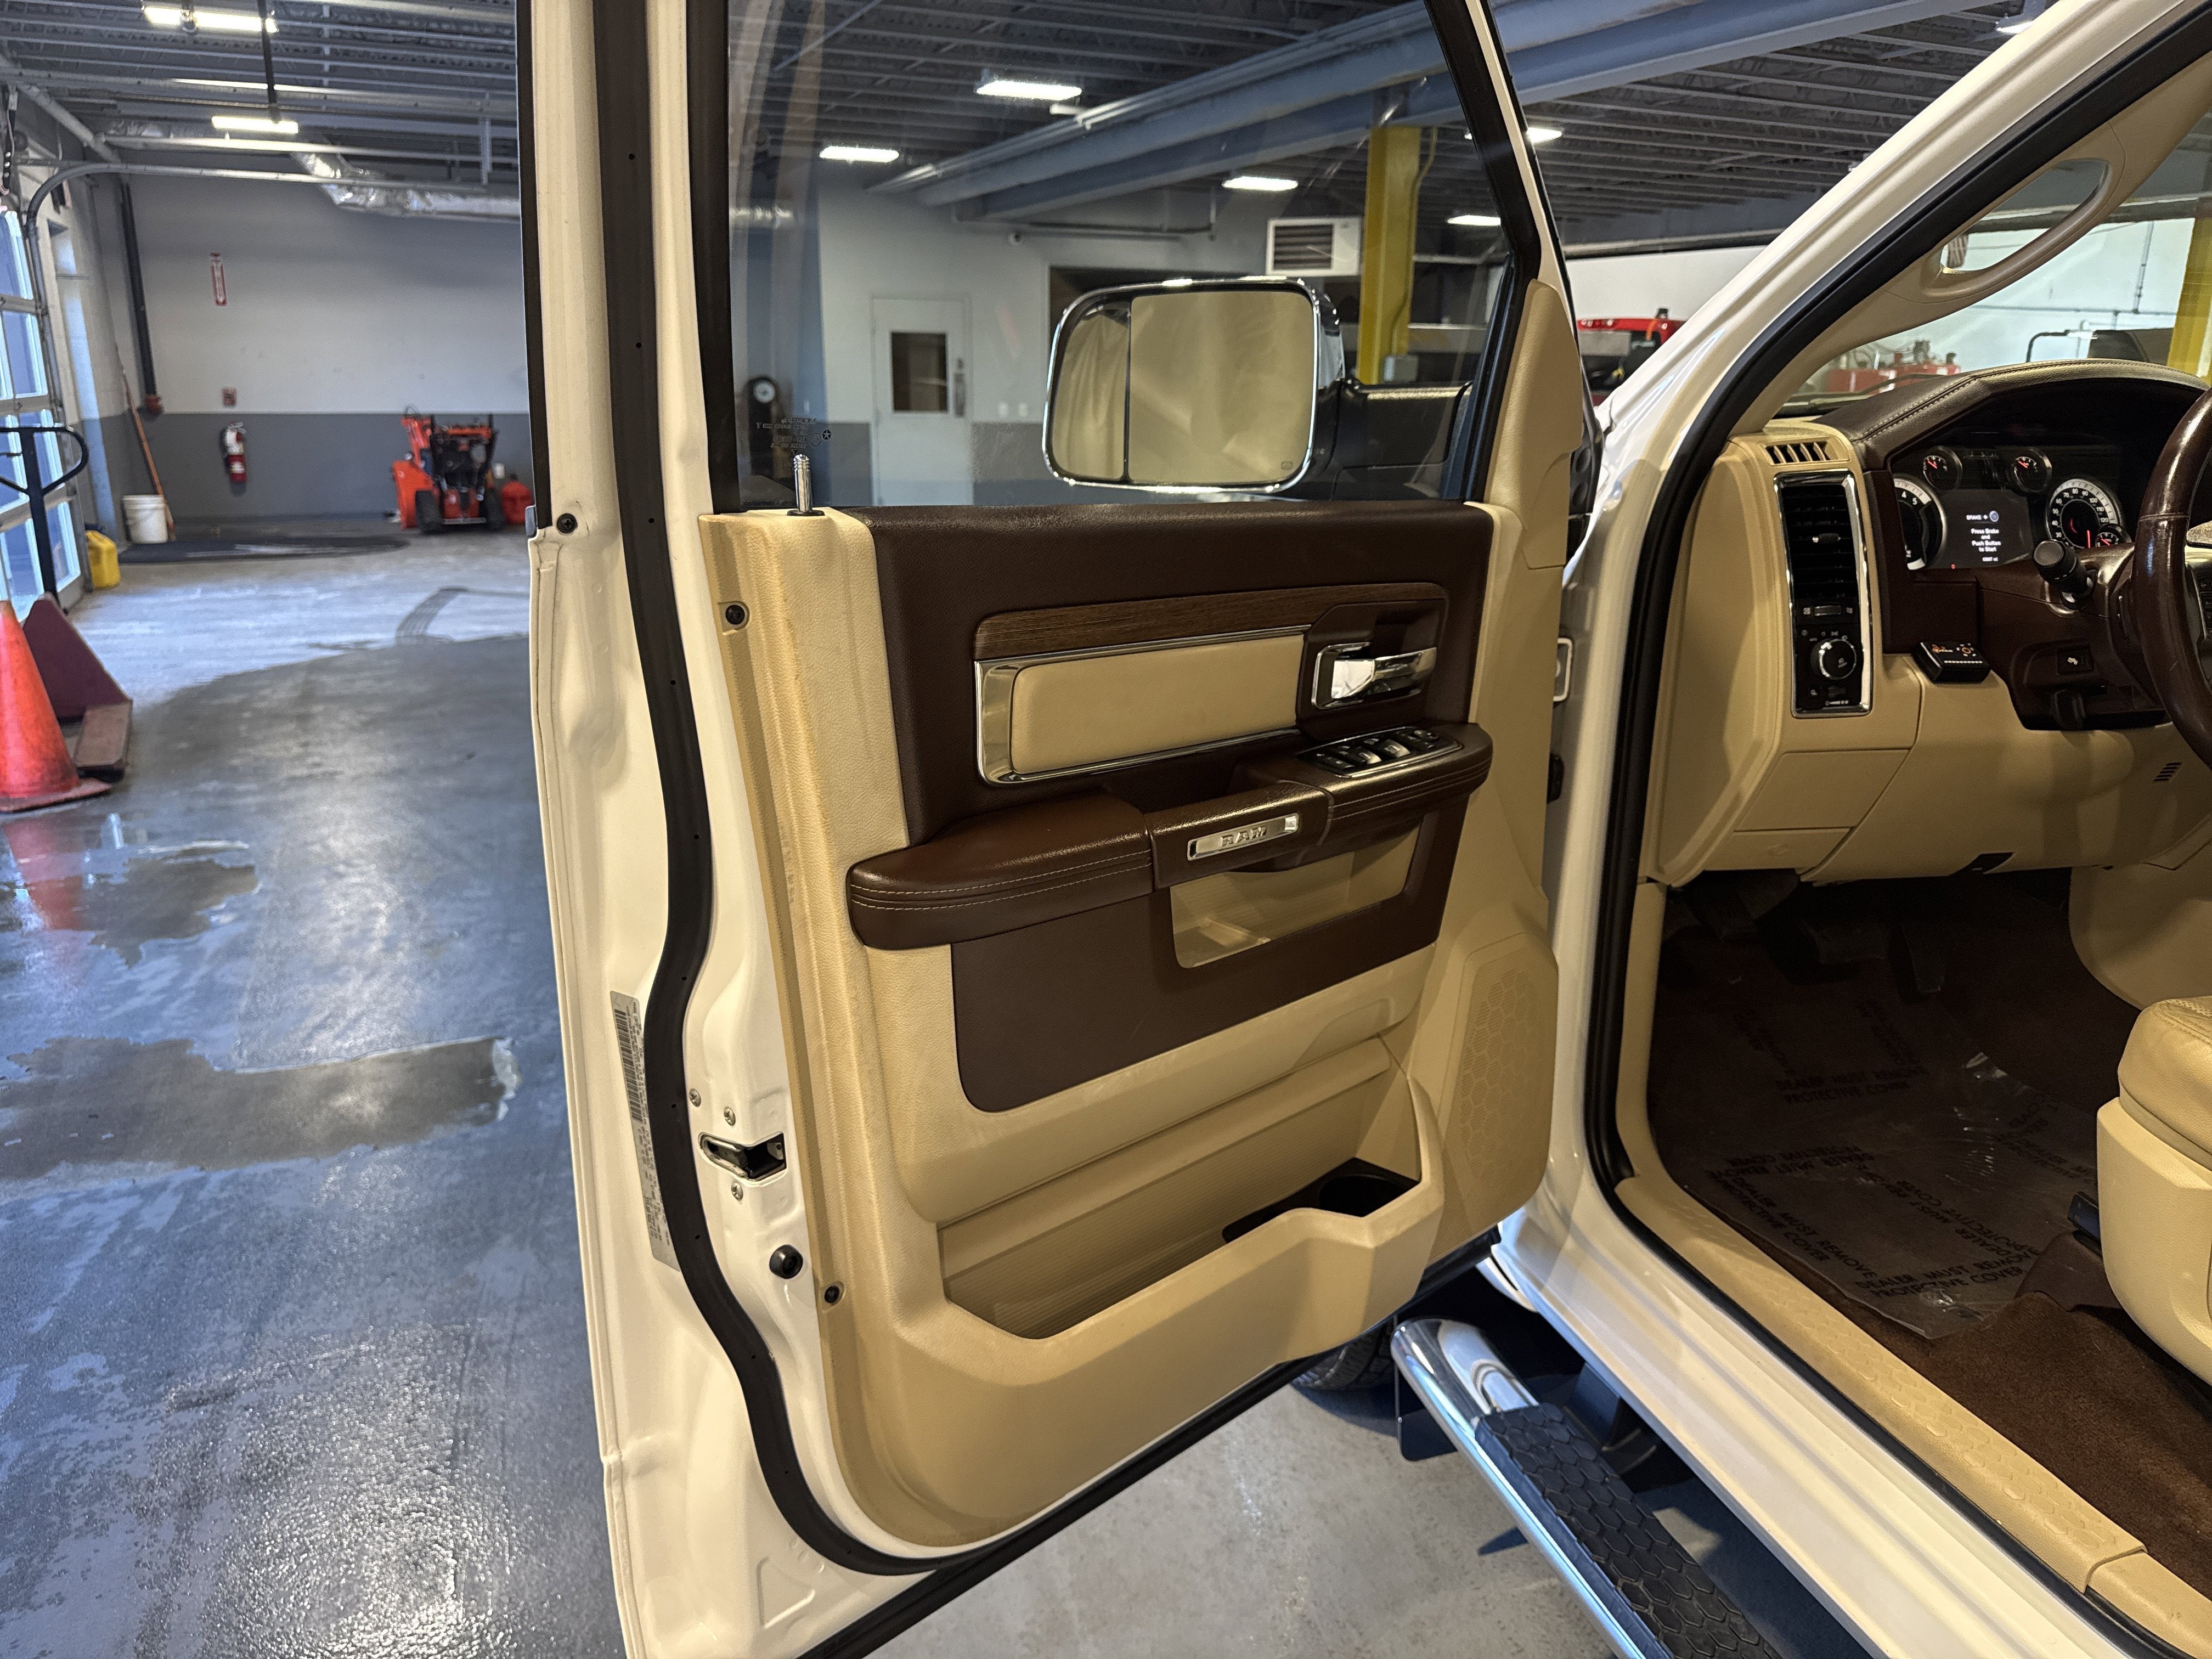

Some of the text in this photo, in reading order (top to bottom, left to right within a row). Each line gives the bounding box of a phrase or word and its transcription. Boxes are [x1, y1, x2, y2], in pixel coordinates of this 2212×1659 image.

[1221, 827, 1267, 847] RAM
[1777, 1212, 1820, 1237] MUST
[1816, 1239, 1878, 1278] REMOVE
[1782, 1232, 1831, 1262] COVER
[1955, 1228, 2012, 1256] DEALER
[1854, 1247, 2041, 1289] DEALER MUST REMOVE
[1970, 1266, 2024, 1284] COVER
